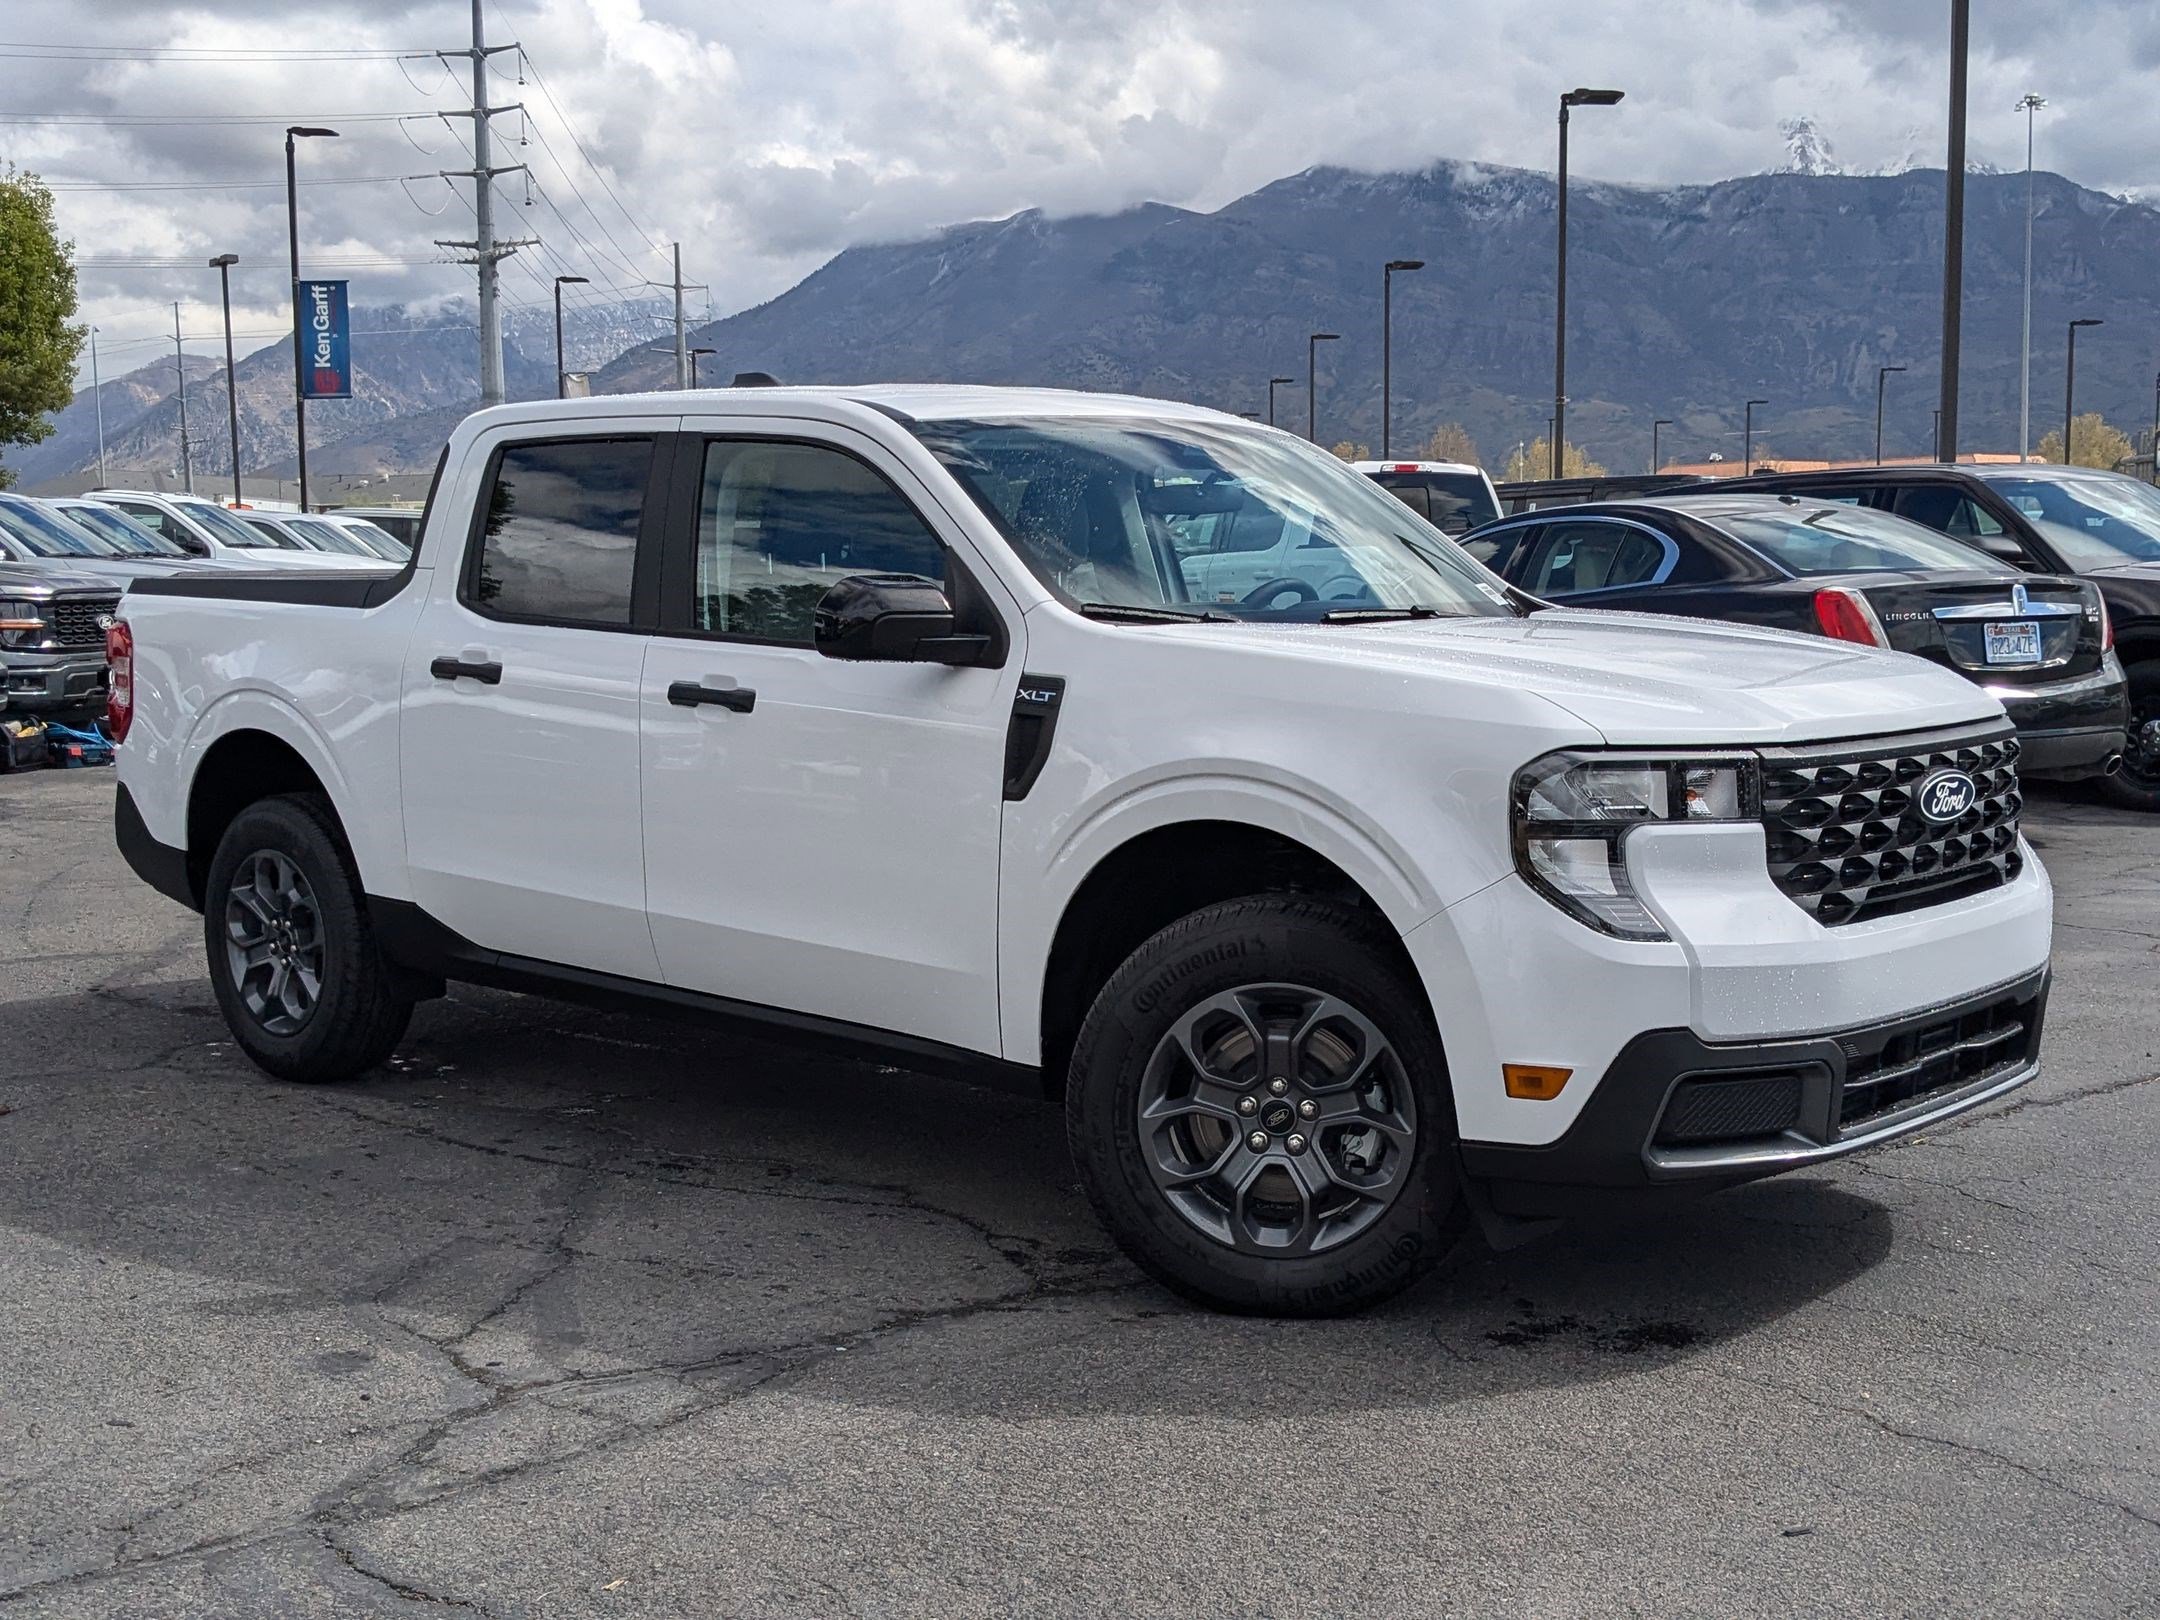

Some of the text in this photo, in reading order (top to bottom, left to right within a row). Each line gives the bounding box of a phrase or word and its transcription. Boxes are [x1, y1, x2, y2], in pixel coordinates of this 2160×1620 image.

[1885, 612, 1929, 621] LINCOLN
[1016, 688, 1057, 702] XLT
[1932, 781, 1967, 814] Ford
[1132, 937, 1247, 1013] Continental
